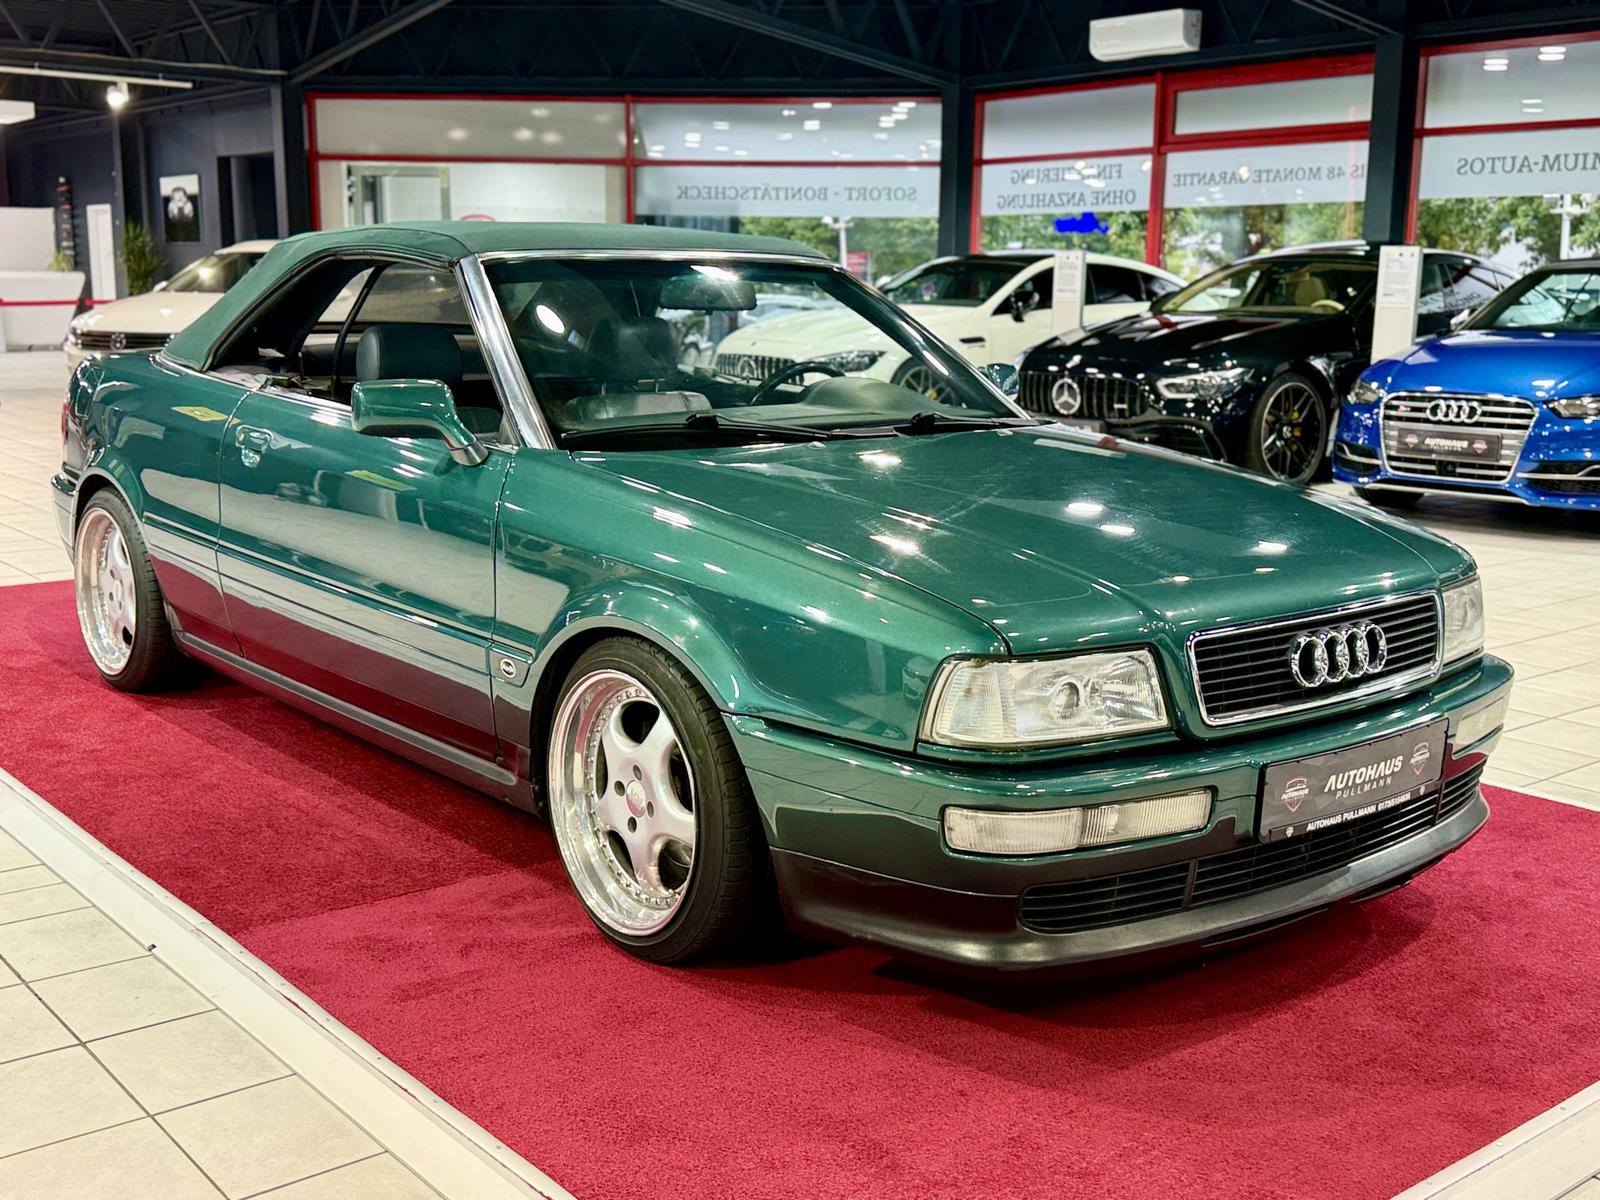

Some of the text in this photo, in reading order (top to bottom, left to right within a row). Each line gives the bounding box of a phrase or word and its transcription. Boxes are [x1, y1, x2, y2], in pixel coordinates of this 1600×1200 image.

[1324, 755, 1404, 793] AUTOHAUS
[1335, 775, 1393, 800] PULLMANN
[1306, 814, 1343, 832] AUTOHAUS
[1343, 805, 1377, 821] PULLMANN
